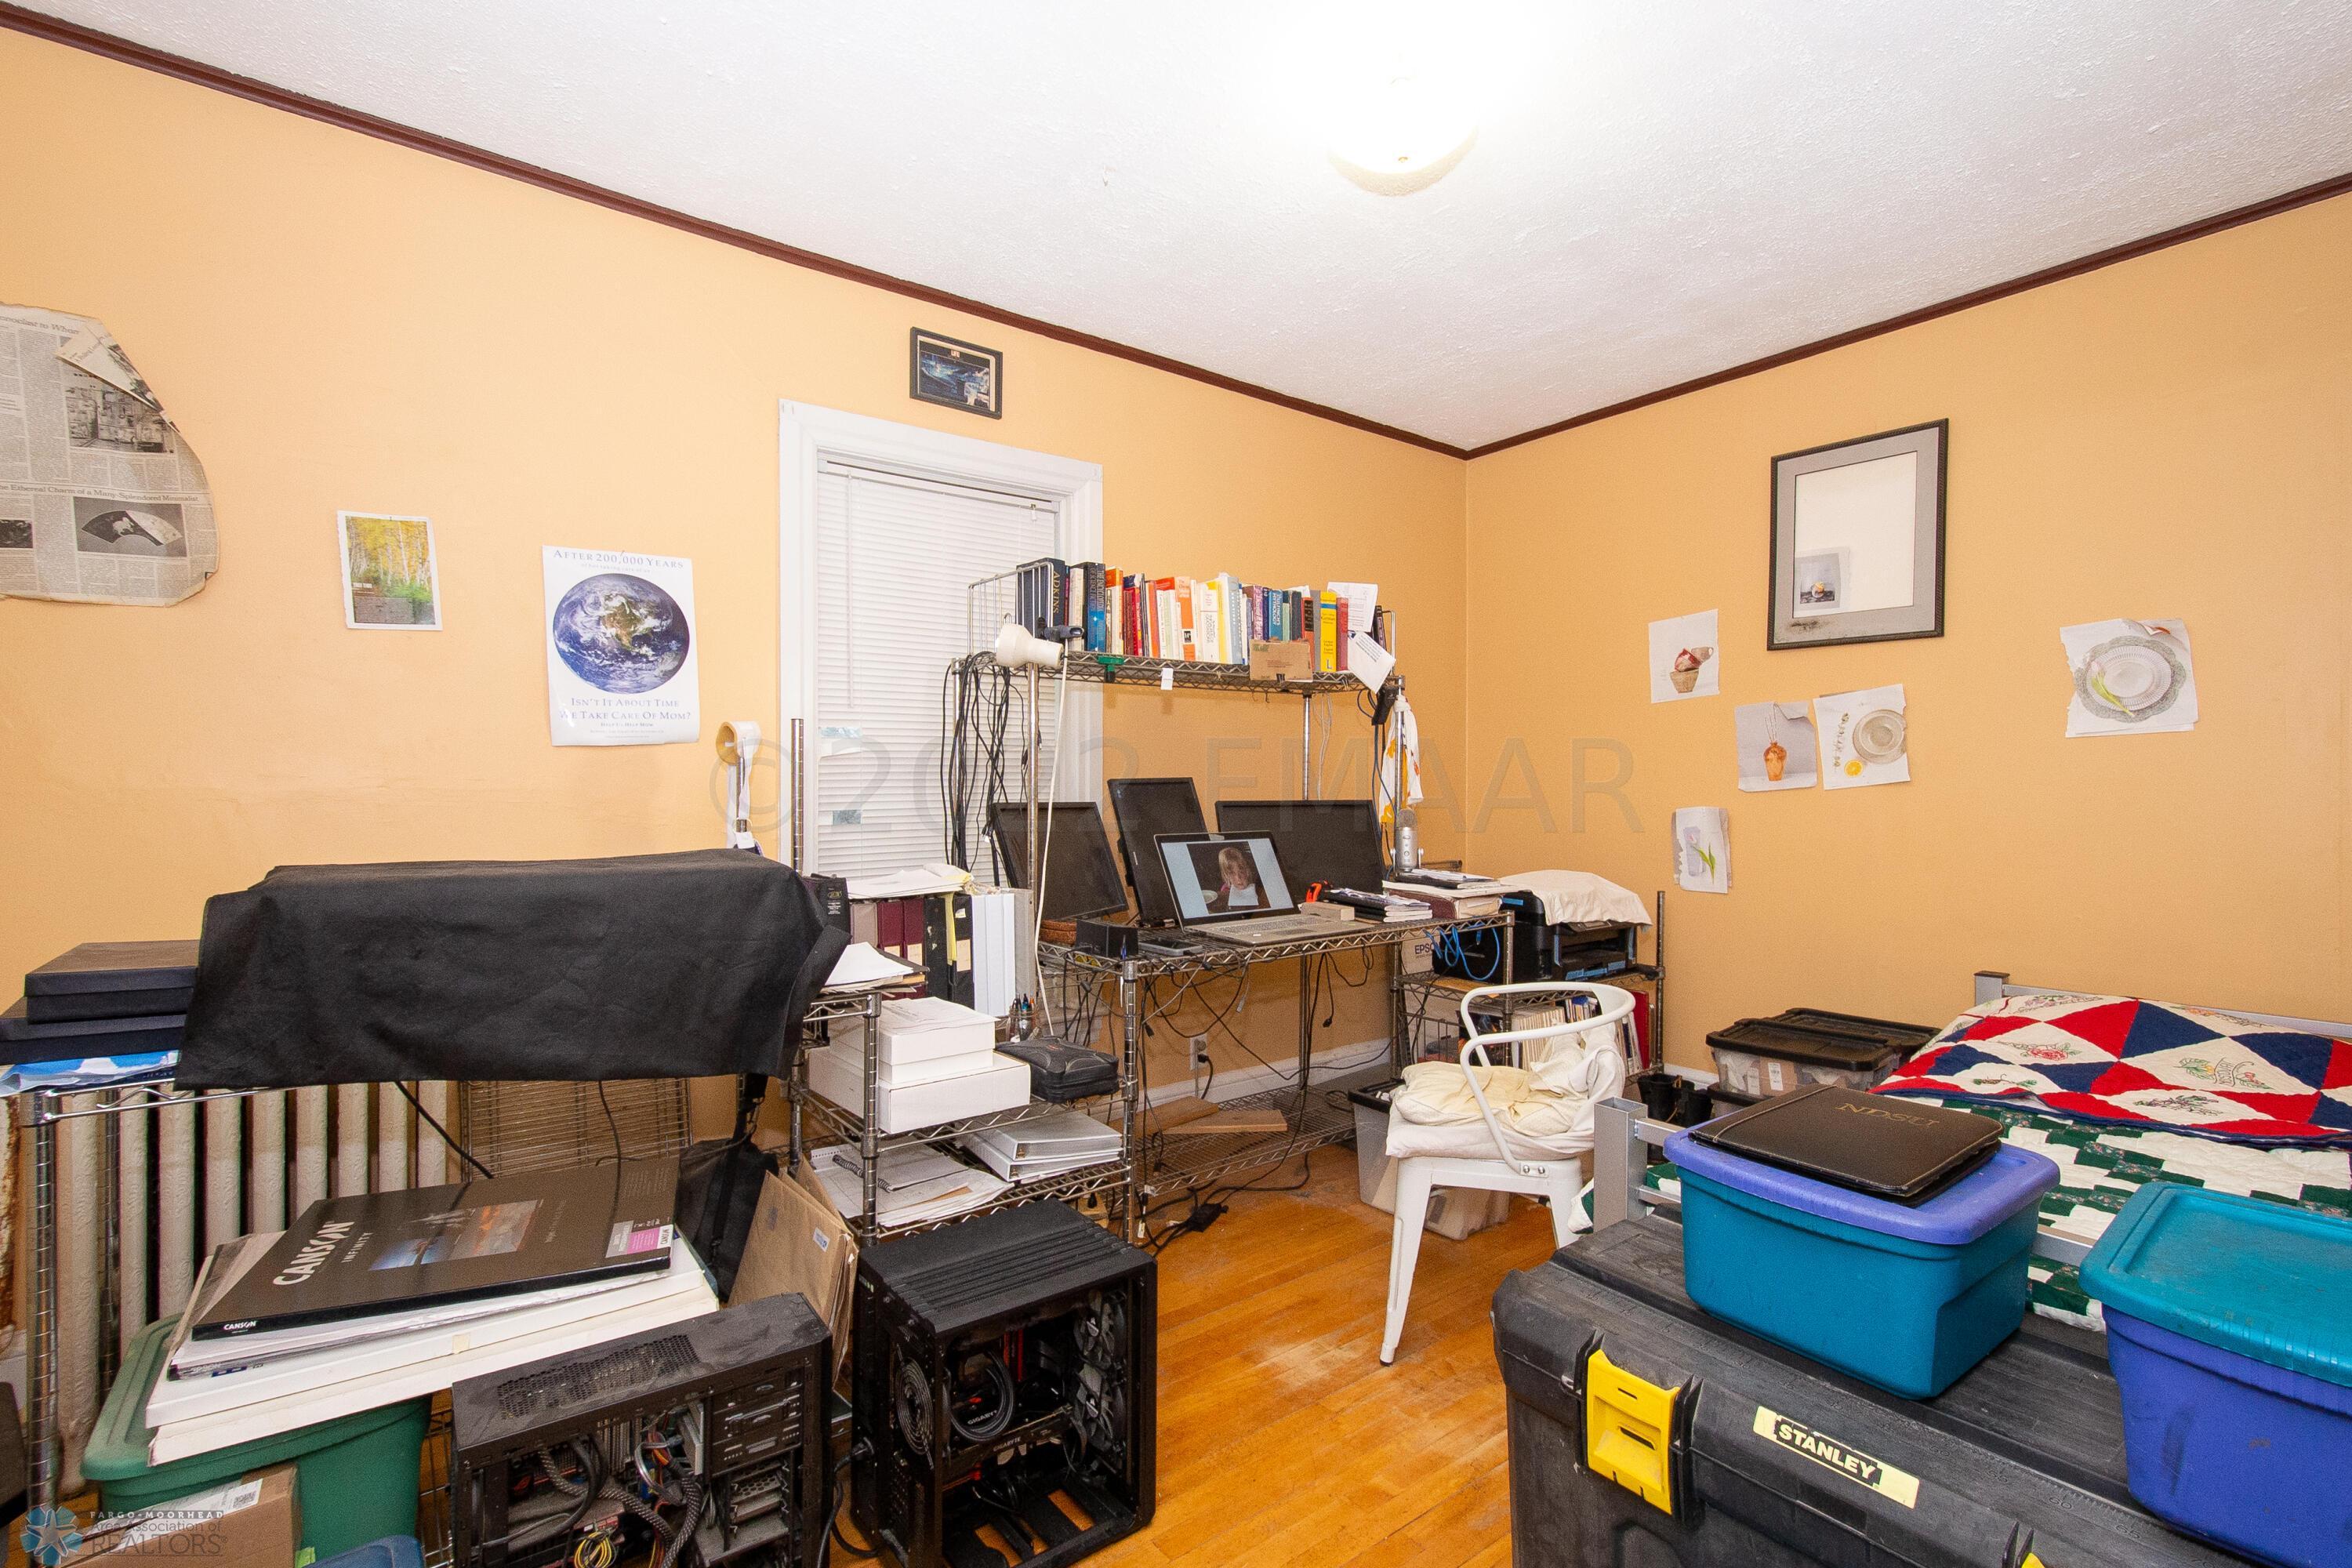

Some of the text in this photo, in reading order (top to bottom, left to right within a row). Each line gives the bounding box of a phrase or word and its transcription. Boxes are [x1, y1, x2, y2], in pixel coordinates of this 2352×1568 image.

[10, 484, 45, 493] Ethereal
[48, 485, 76, 495] Charm
[554, 550, 684, 569] AFTER 200,000 YEARS
[571, 697, 680, 707] ISN'T IT ABOUT TIME
[581, 710, 608, 720] TAKE
[612, 710, 640, 720] CARE
[642, 710, 657, 720] OF
[659, 710, 691, 720] MOM?
[1835, 1102, 1940, 1129] NDSU
[272, 1221, 355, 1286] CANSON
[340, 1232, 374, 1264] INFINITY
[223, 1320, 257, 1330] CANSON
[993, 1436, 1022, 1452] GIGABYTE
[1778, 1424, 1877, 1480] STANLEY
[2049, 1496, 2073, 1510] 60
